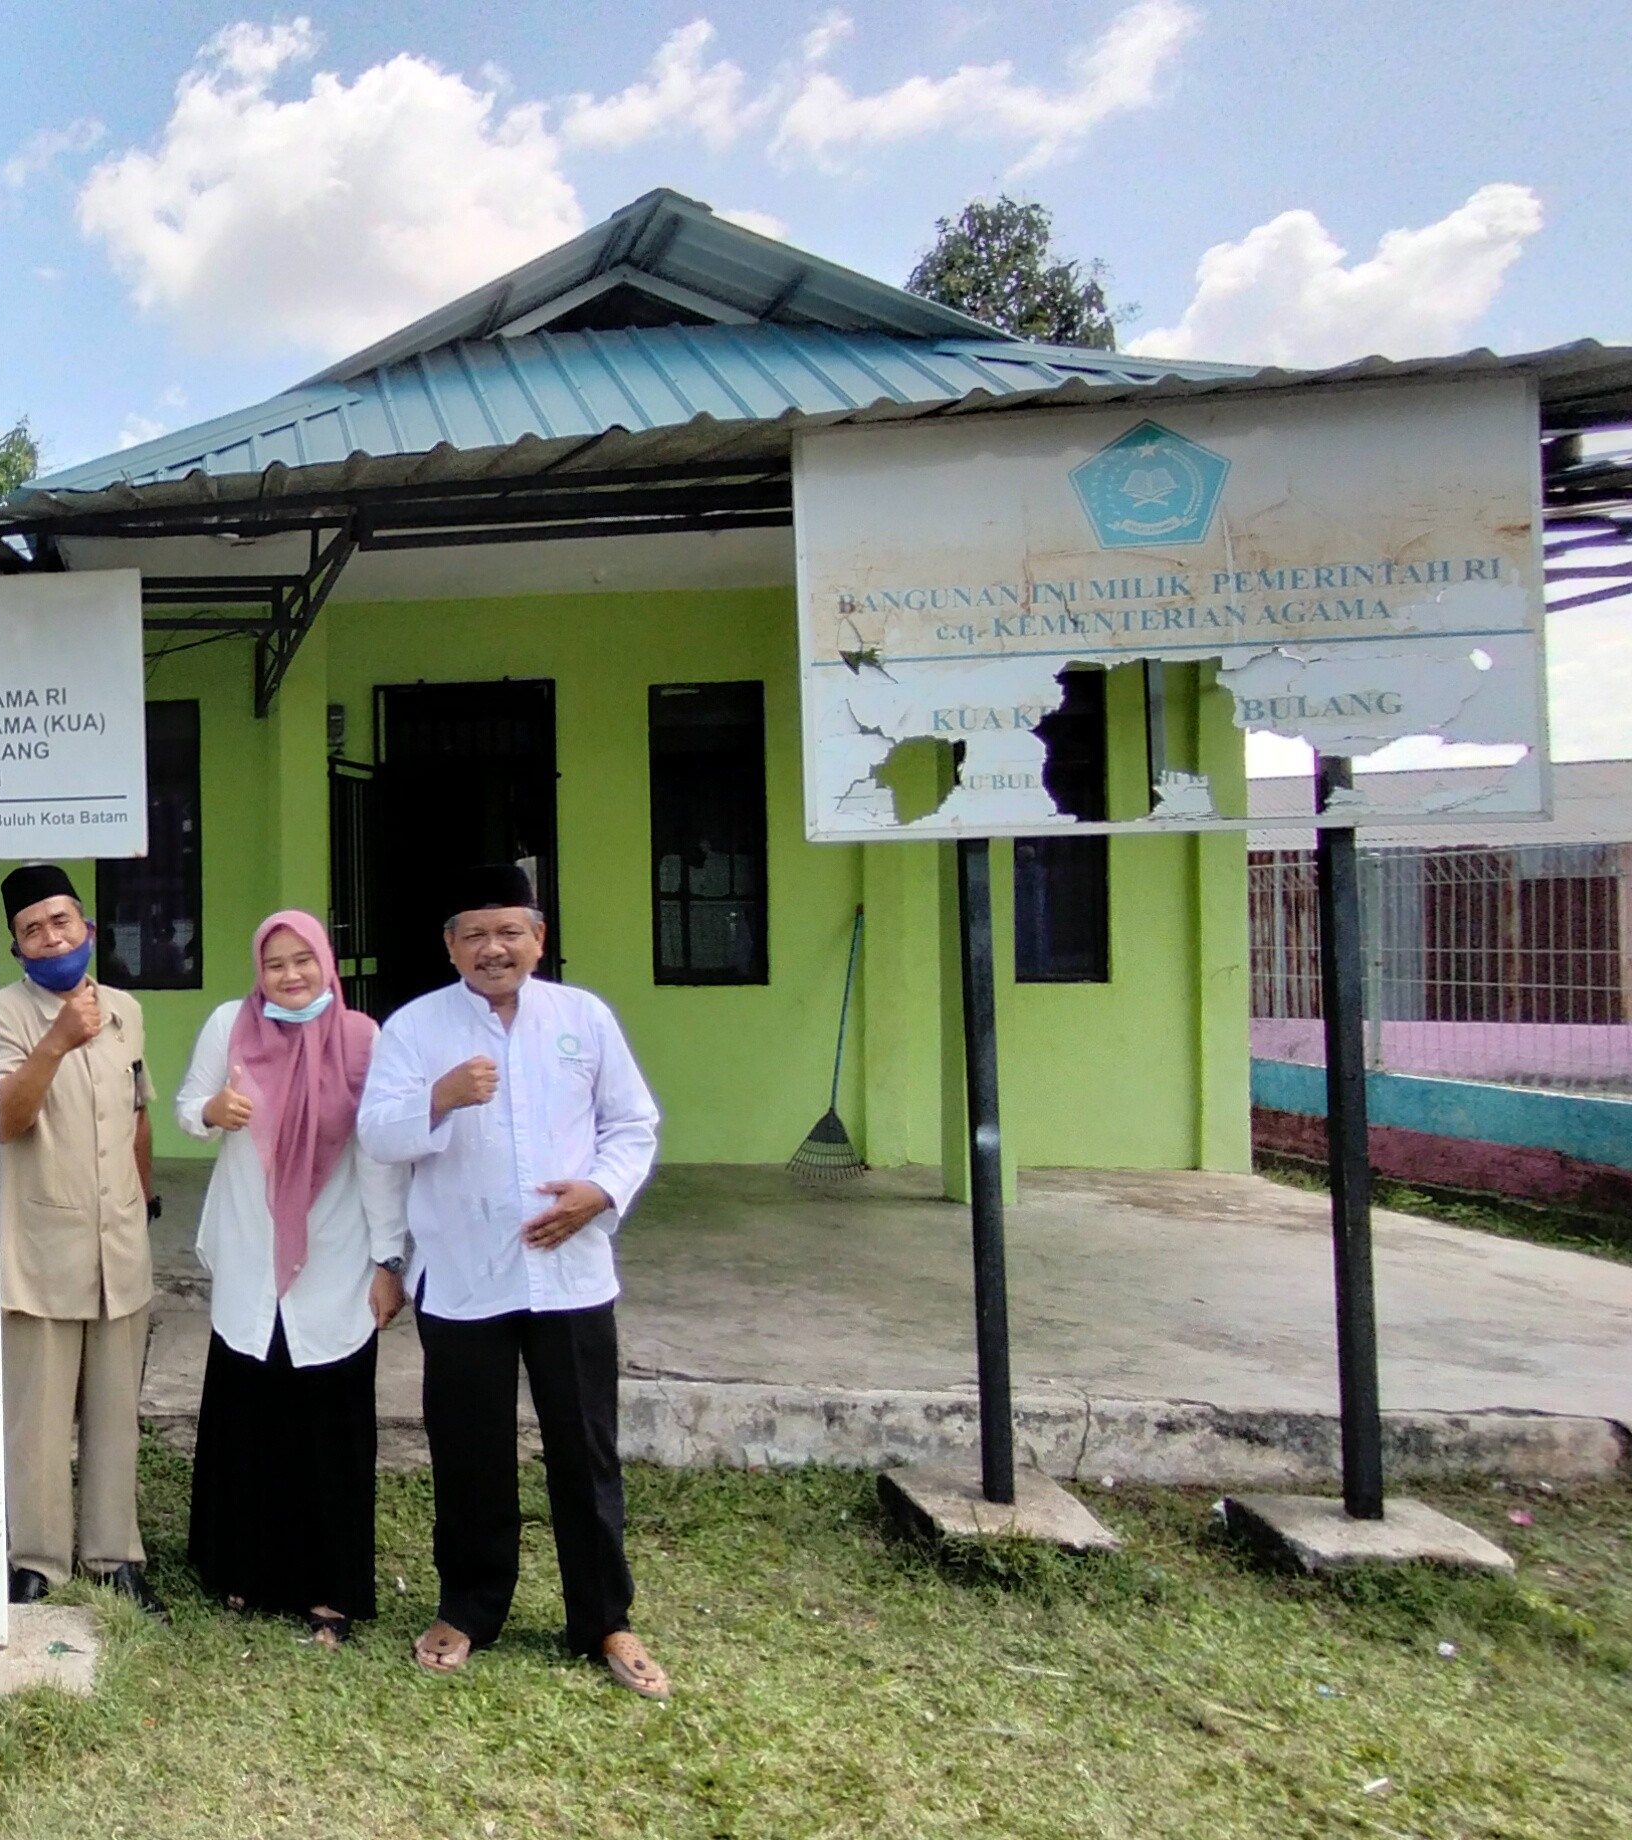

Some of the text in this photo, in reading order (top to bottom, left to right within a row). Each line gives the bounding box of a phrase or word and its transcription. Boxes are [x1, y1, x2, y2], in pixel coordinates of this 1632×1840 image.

[838, 557, 1502, 615] BANGUNAN INI MILIK PEMERINTAH RI
[993, 604, 1247, 638] KEMENTERIAN
[1256, 597, 1393, 625] AGAMA
[45, 687, 68, 706] RI
[930, 707, 1003, 731] KUA
[1241, 691, 1404, 723] BULANG
[43, 712, 106, 737] (KUA)
[40, 811, 75, 826] Kota
[79, 810, 129, 824] Batam
